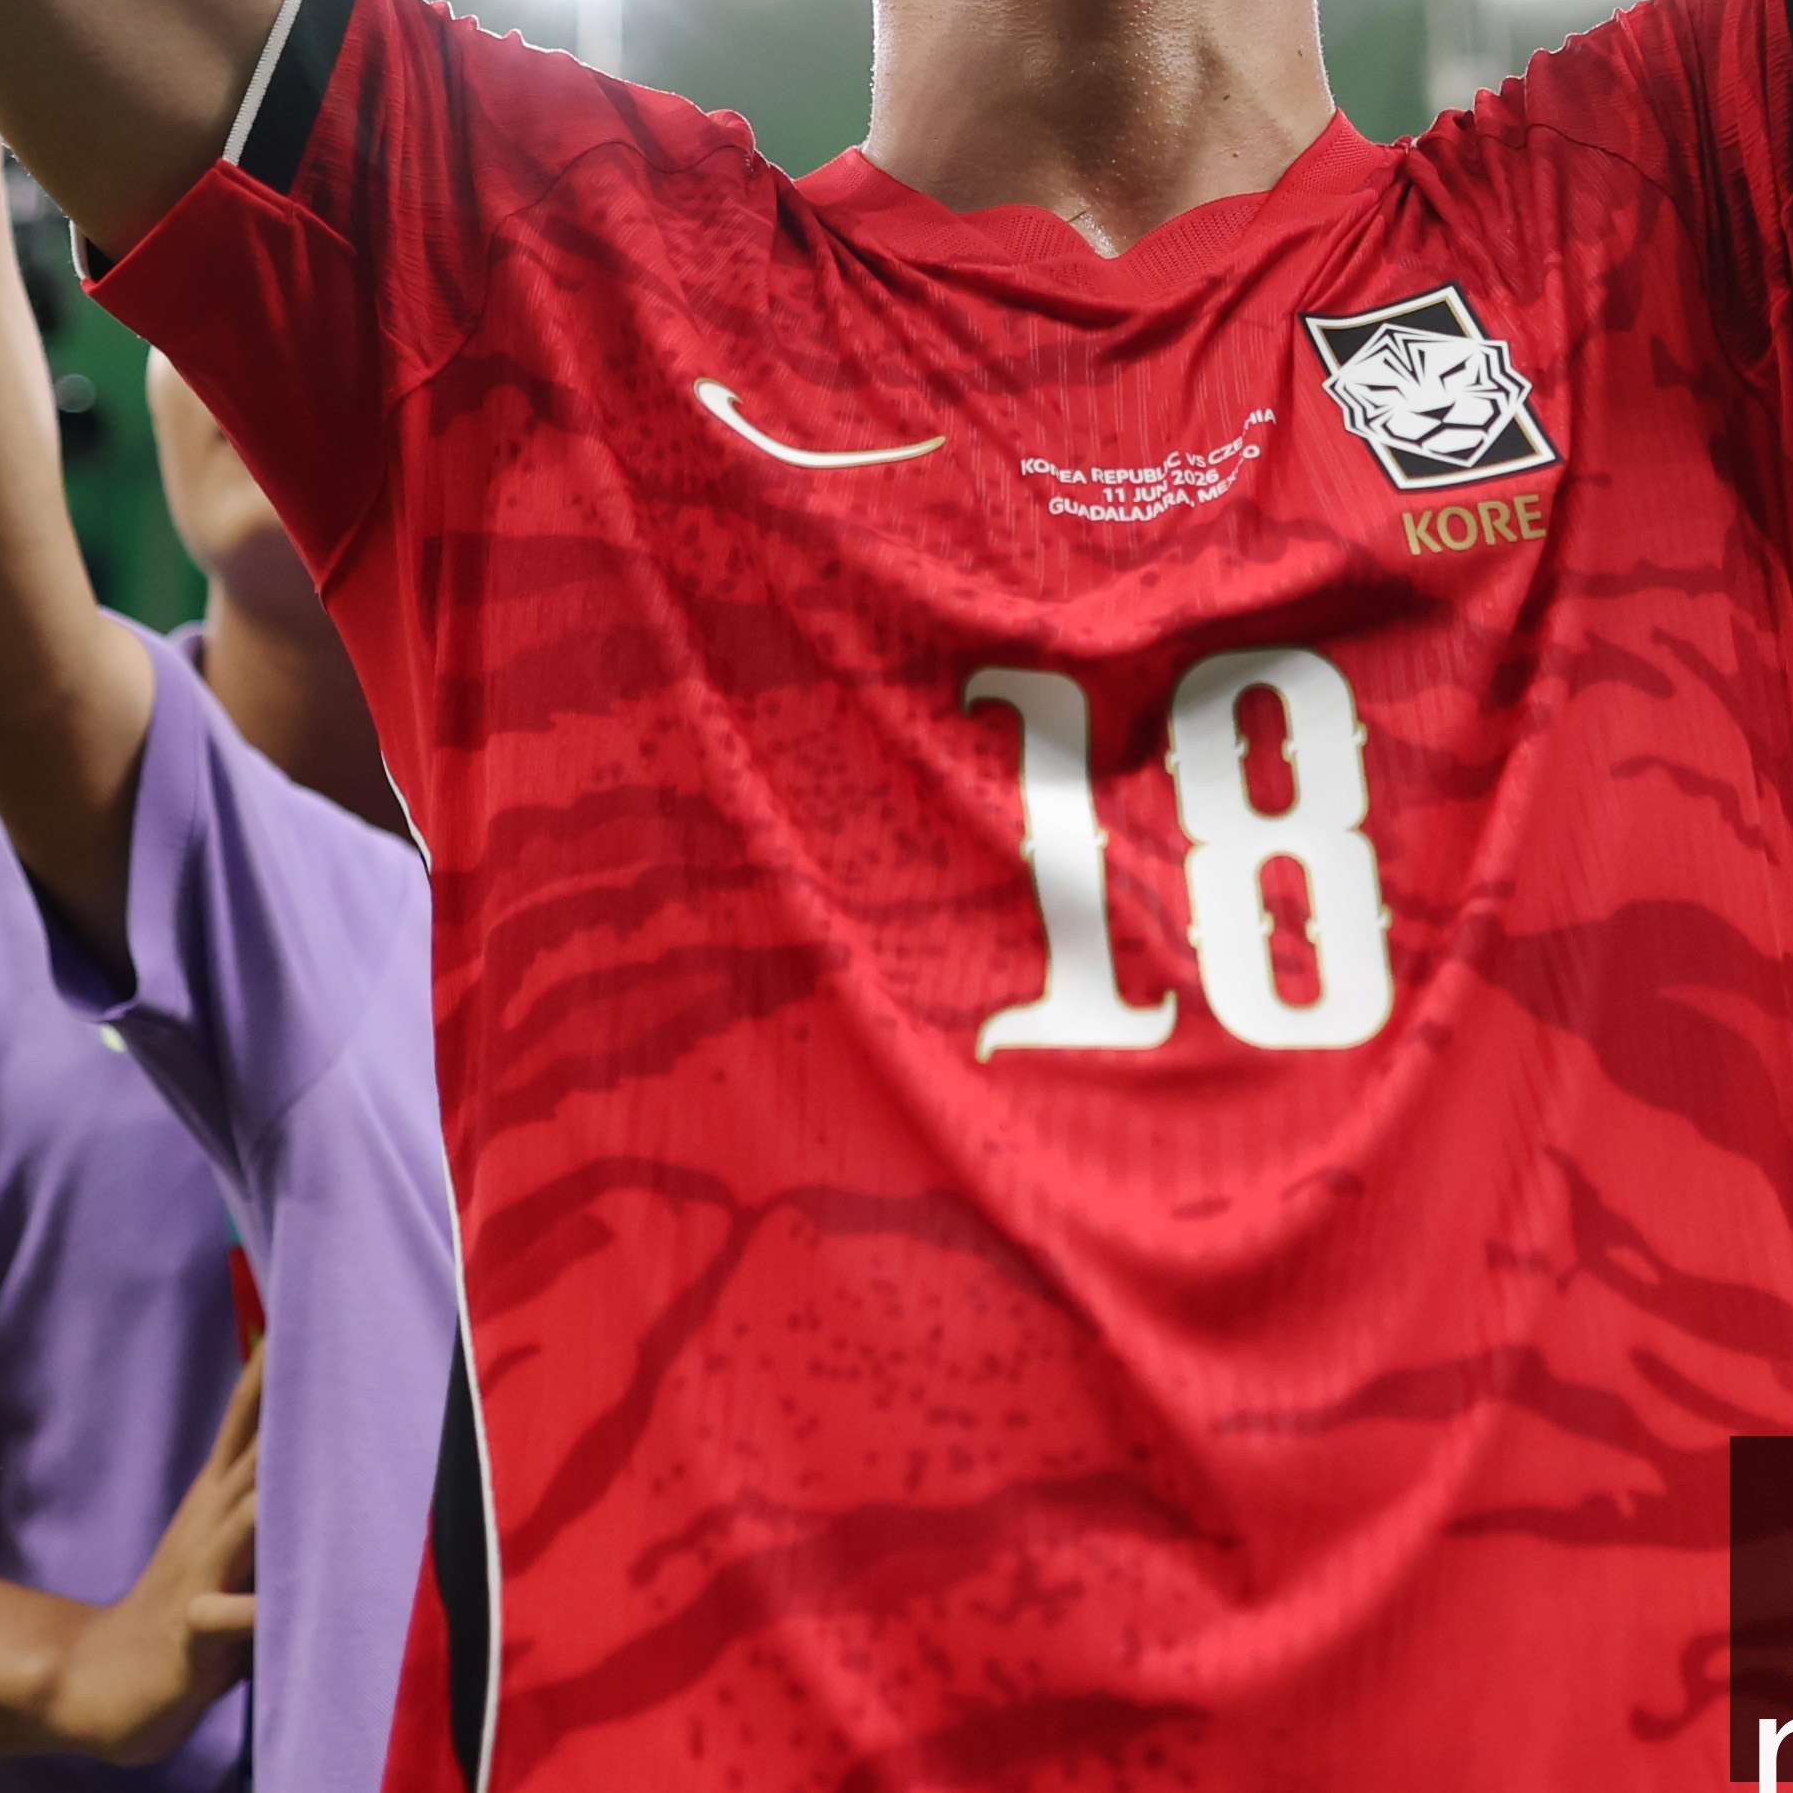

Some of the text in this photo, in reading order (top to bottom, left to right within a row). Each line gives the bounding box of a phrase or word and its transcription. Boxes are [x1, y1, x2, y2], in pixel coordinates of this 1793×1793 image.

[1091, 451, 1182, 484] REPUBLIC
[1185, 452, 1207, 468] VS
[1103, 469, 1220, 503] 11 JUN 2026
[1048, 496, 1195, 522] GUADALAJARA,
[963, 646, 1395, 1064] 18
